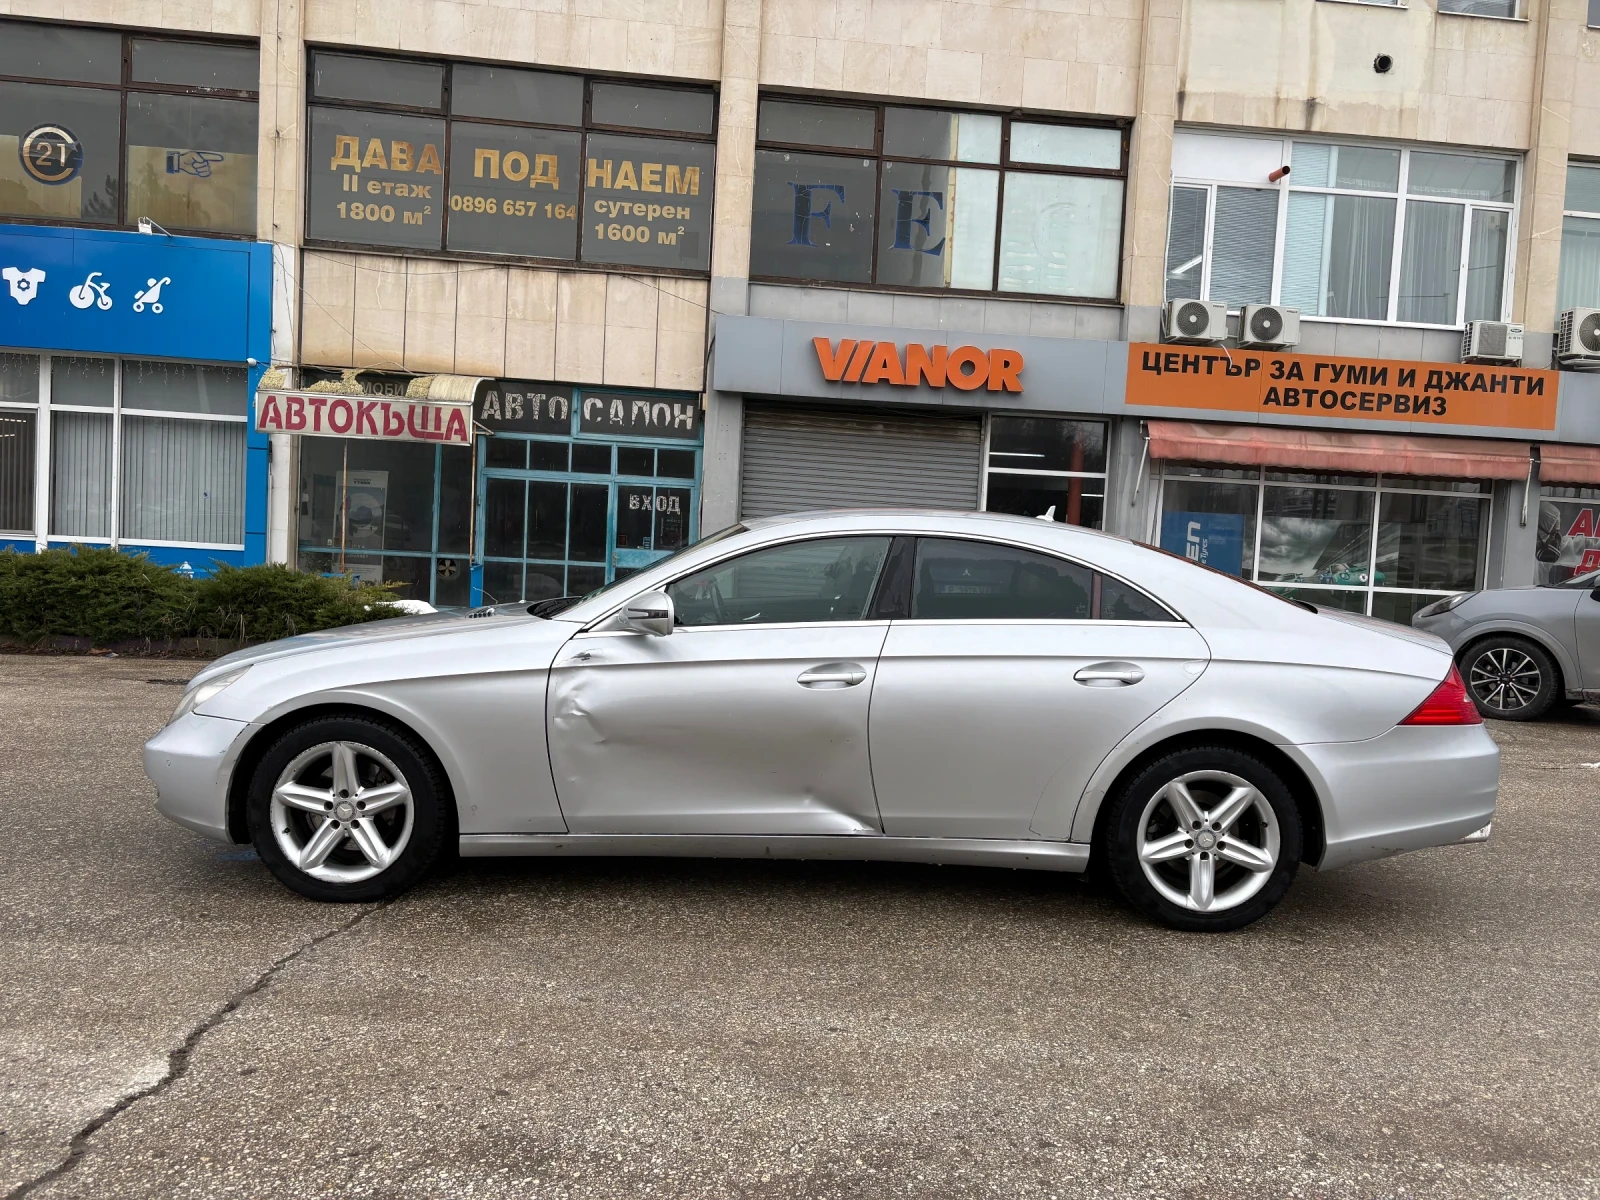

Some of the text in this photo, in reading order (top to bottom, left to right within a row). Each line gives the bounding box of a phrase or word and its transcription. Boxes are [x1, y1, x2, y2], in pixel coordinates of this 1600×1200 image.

[36, 142, 66, 167] 21
[330, 134, 700, 196] ДАВА ПОД НАЕМ
[367, 180, 432, 199] етаж
[336, 201, 395, 222] 1800
[450, 194, 576, 220] 0896 657 164
[594, 199, 690, 221] сутерен
[594, 222, 650, 243] 1600
[812, 337, 1025, 392] VIANOR
[1142, 351, 1545, 396] ЦЕНТЪР ЗА ГУМИ И ДЖАНТИ
[480, 390, 694, 430] АВТО САЛОН
[1262, 387, 1447, 416] АВТОСЕРВИЗ
[258, 395, 468, 442] АВТОКЪЩА
[629, 493, 680, 515] ВХОД
[1566, 507, 1600, 539] А
[1200, 538, 1209, 559] Tyres
